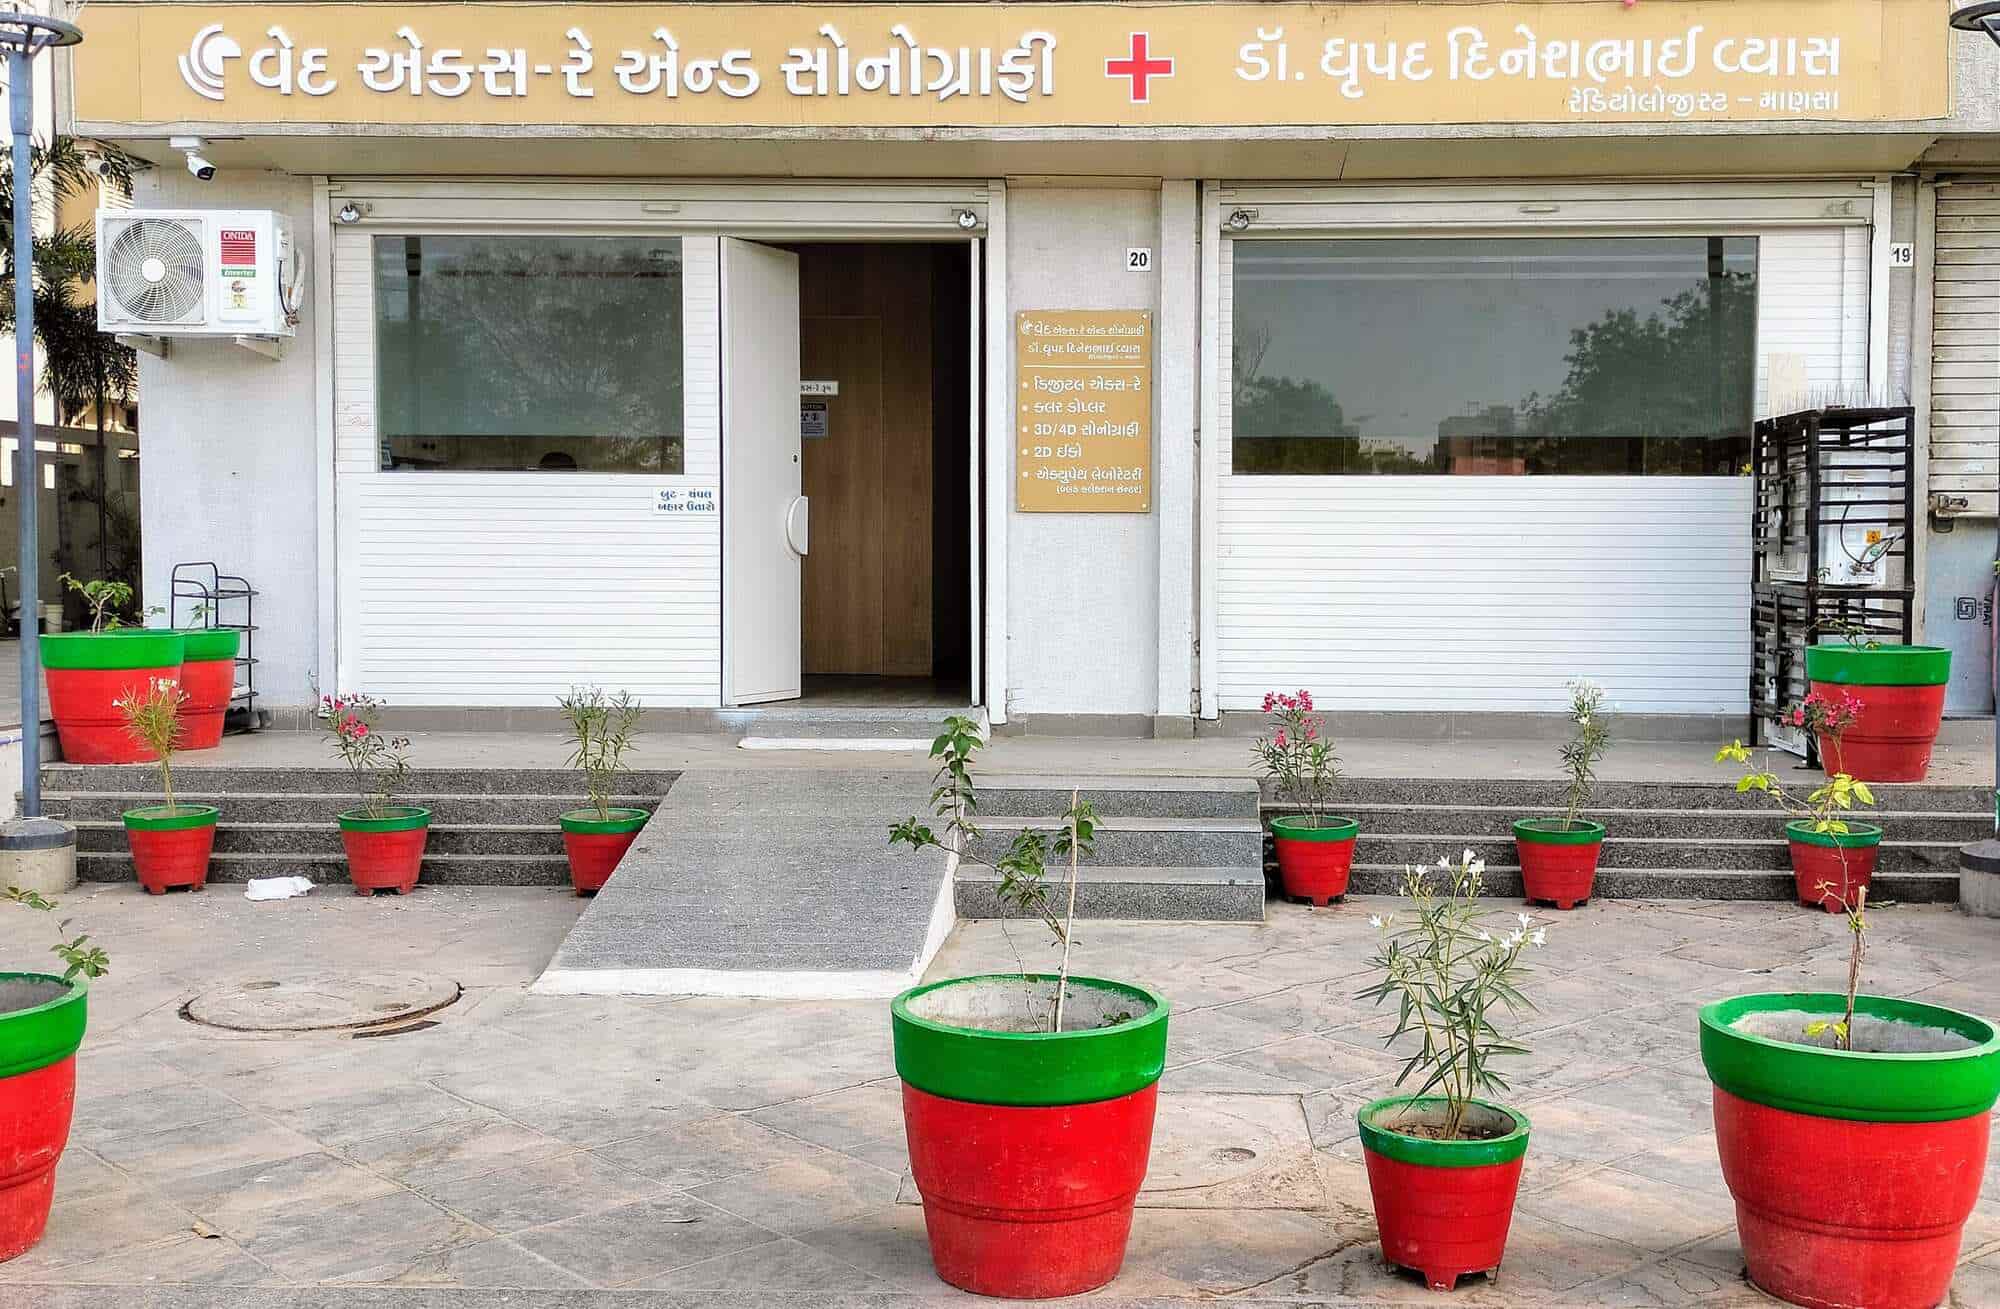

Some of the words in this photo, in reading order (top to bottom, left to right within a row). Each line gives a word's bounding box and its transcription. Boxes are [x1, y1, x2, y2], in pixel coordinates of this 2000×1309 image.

[1446, 23, 1705, 83] દિનેશભાઈ
[1712, 36, 1841, 78] વ્યાસ
[248, 26, 338, 97] વેદ
[613, 28, 762, 98] એન્ડ
[779, 24, 1058, 103] સોનોગ્રાફી
[1568, 86, 1729, 117] રેડિયોલોજીસ્ટ
[1758, 90, 1840, 114] માણસા
[223, 232, 254, 240] ONIDA
[1130, 252, 1147, 267] 20
[1891, 247, 1911, 263] 19
[1034, 422, 1078, 438] 3D/4D
